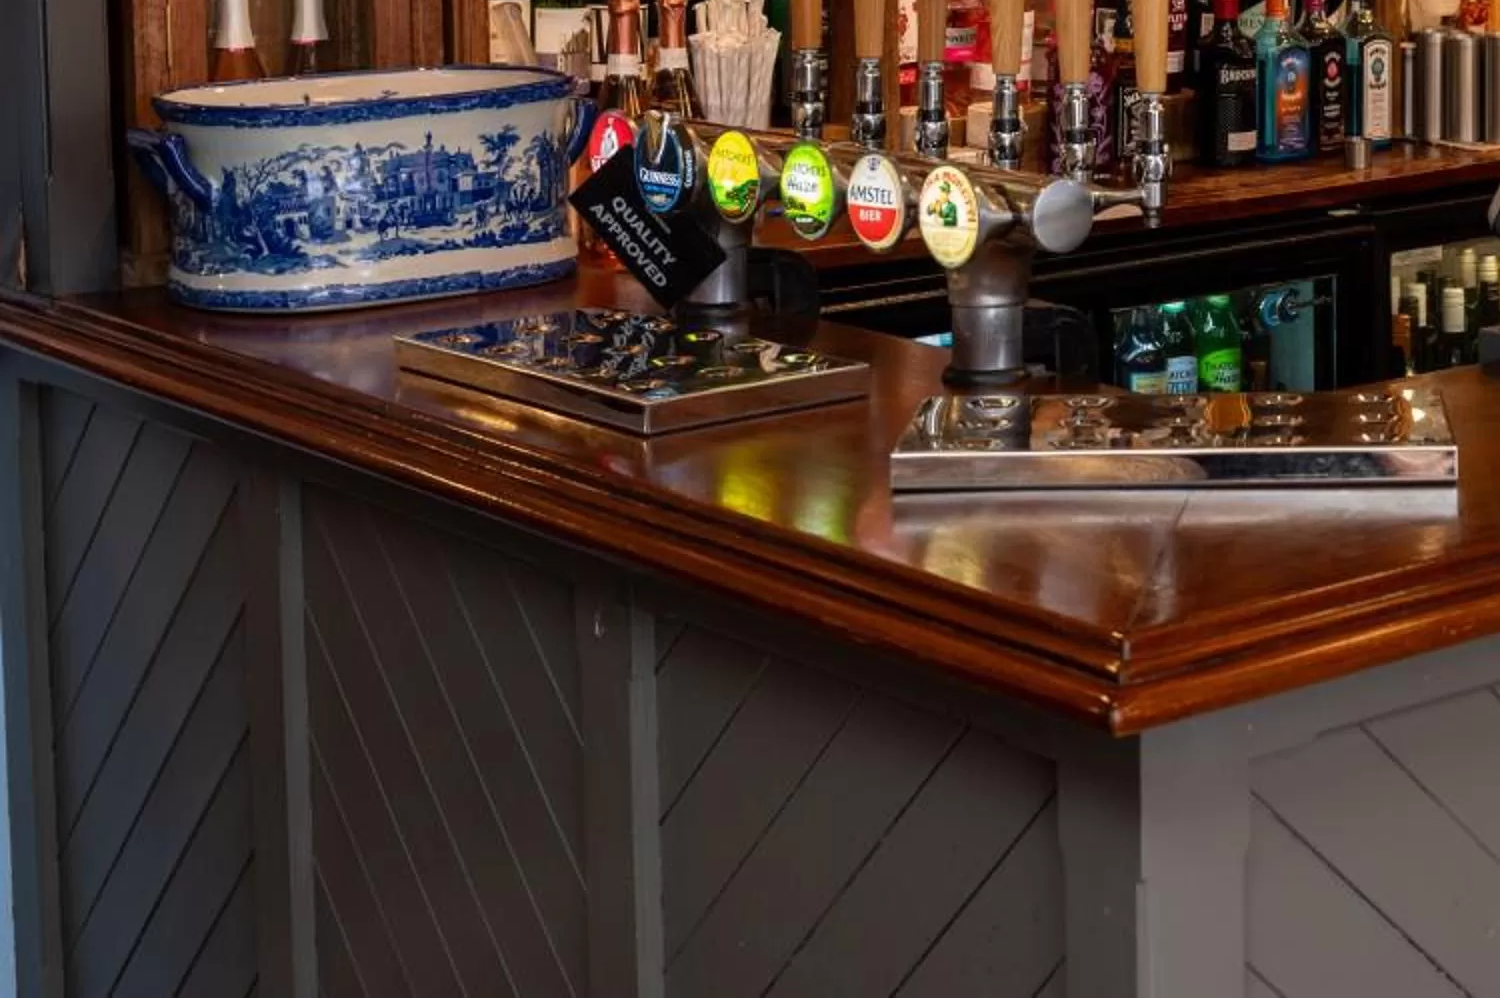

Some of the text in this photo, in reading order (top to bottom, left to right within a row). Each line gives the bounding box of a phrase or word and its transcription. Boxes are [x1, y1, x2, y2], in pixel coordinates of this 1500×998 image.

[850, 185, 893, 205] AMSTEL
[860, 209, 882, 222] BIER
[589, 202, 667, 288] APPROVED
[612, 195, 678, 266] QUALITY
